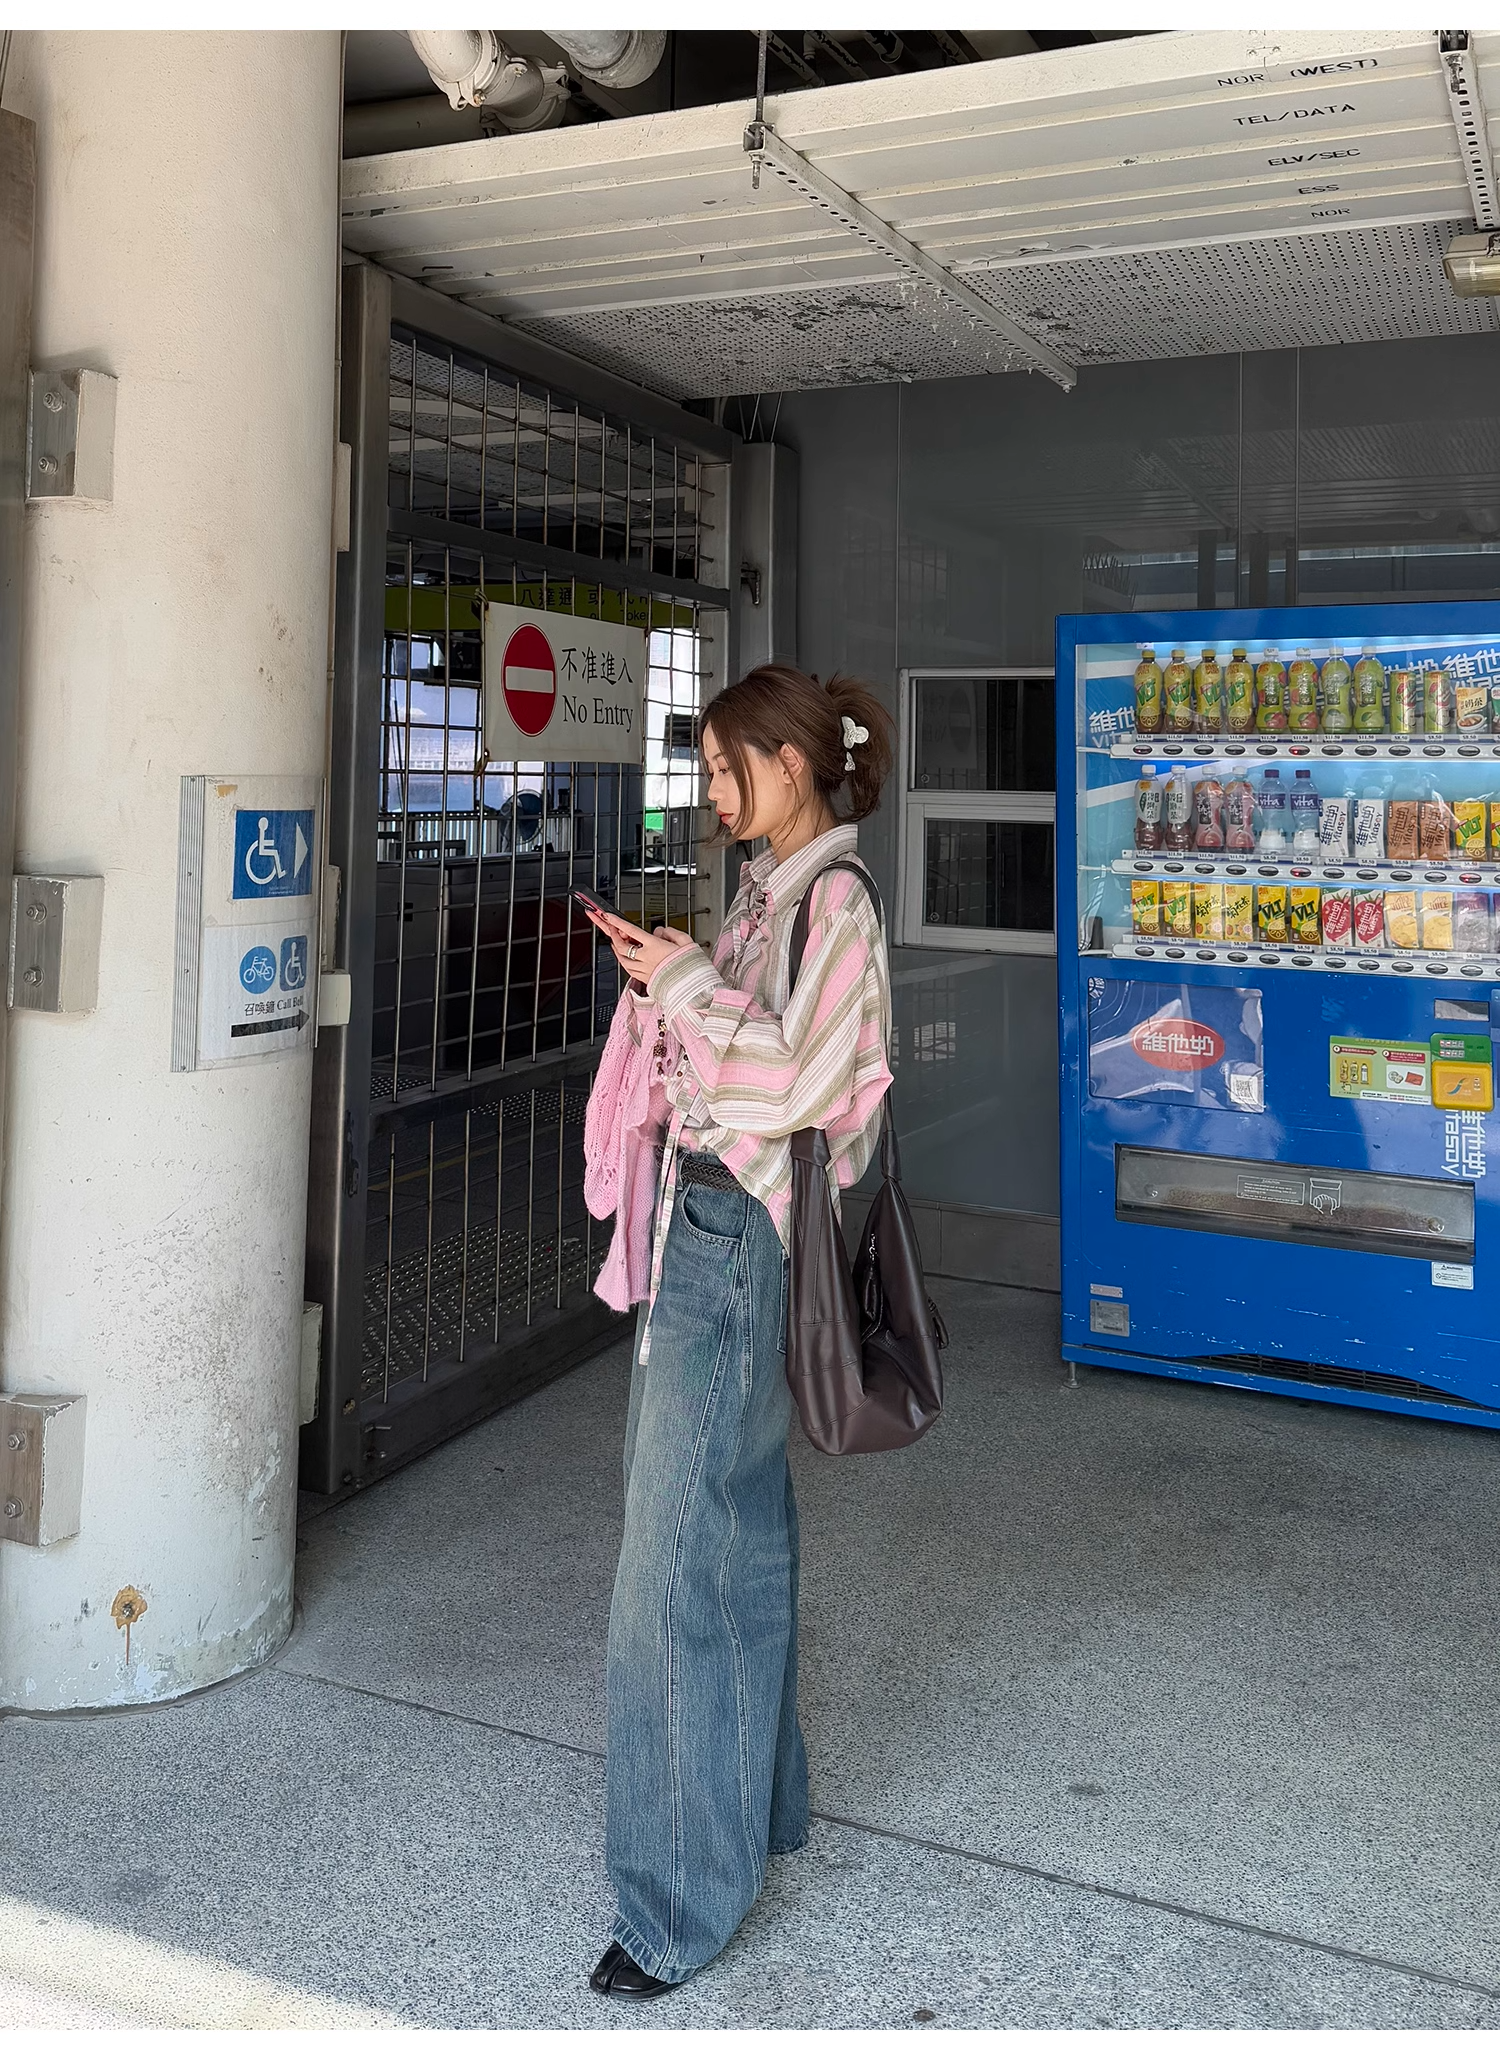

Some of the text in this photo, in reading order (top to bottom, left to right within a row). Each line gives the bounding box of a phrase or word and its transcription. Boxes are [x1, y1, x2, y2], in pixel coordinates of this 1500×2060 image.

[1217, 58, 1378, 87] NOR (WEST)
[1232, 103, 1356, 126] TEL/DATA
[1268, 148, 1361, 167] ELV/SEC
[1297, 183, 1340, 195] ESS
[1310, 207, 1351, 219] NOR
[560, 646, 634, 686] 不准進入
[562, 695, 634, 733] No Entry
[1294, 795, 1314, 806] vita
[1226, 895, 1250, 919] 菊花茶
[276, 999, 292, 1011] Call
[1142, 1031, 1214, 1057] 維他奶
